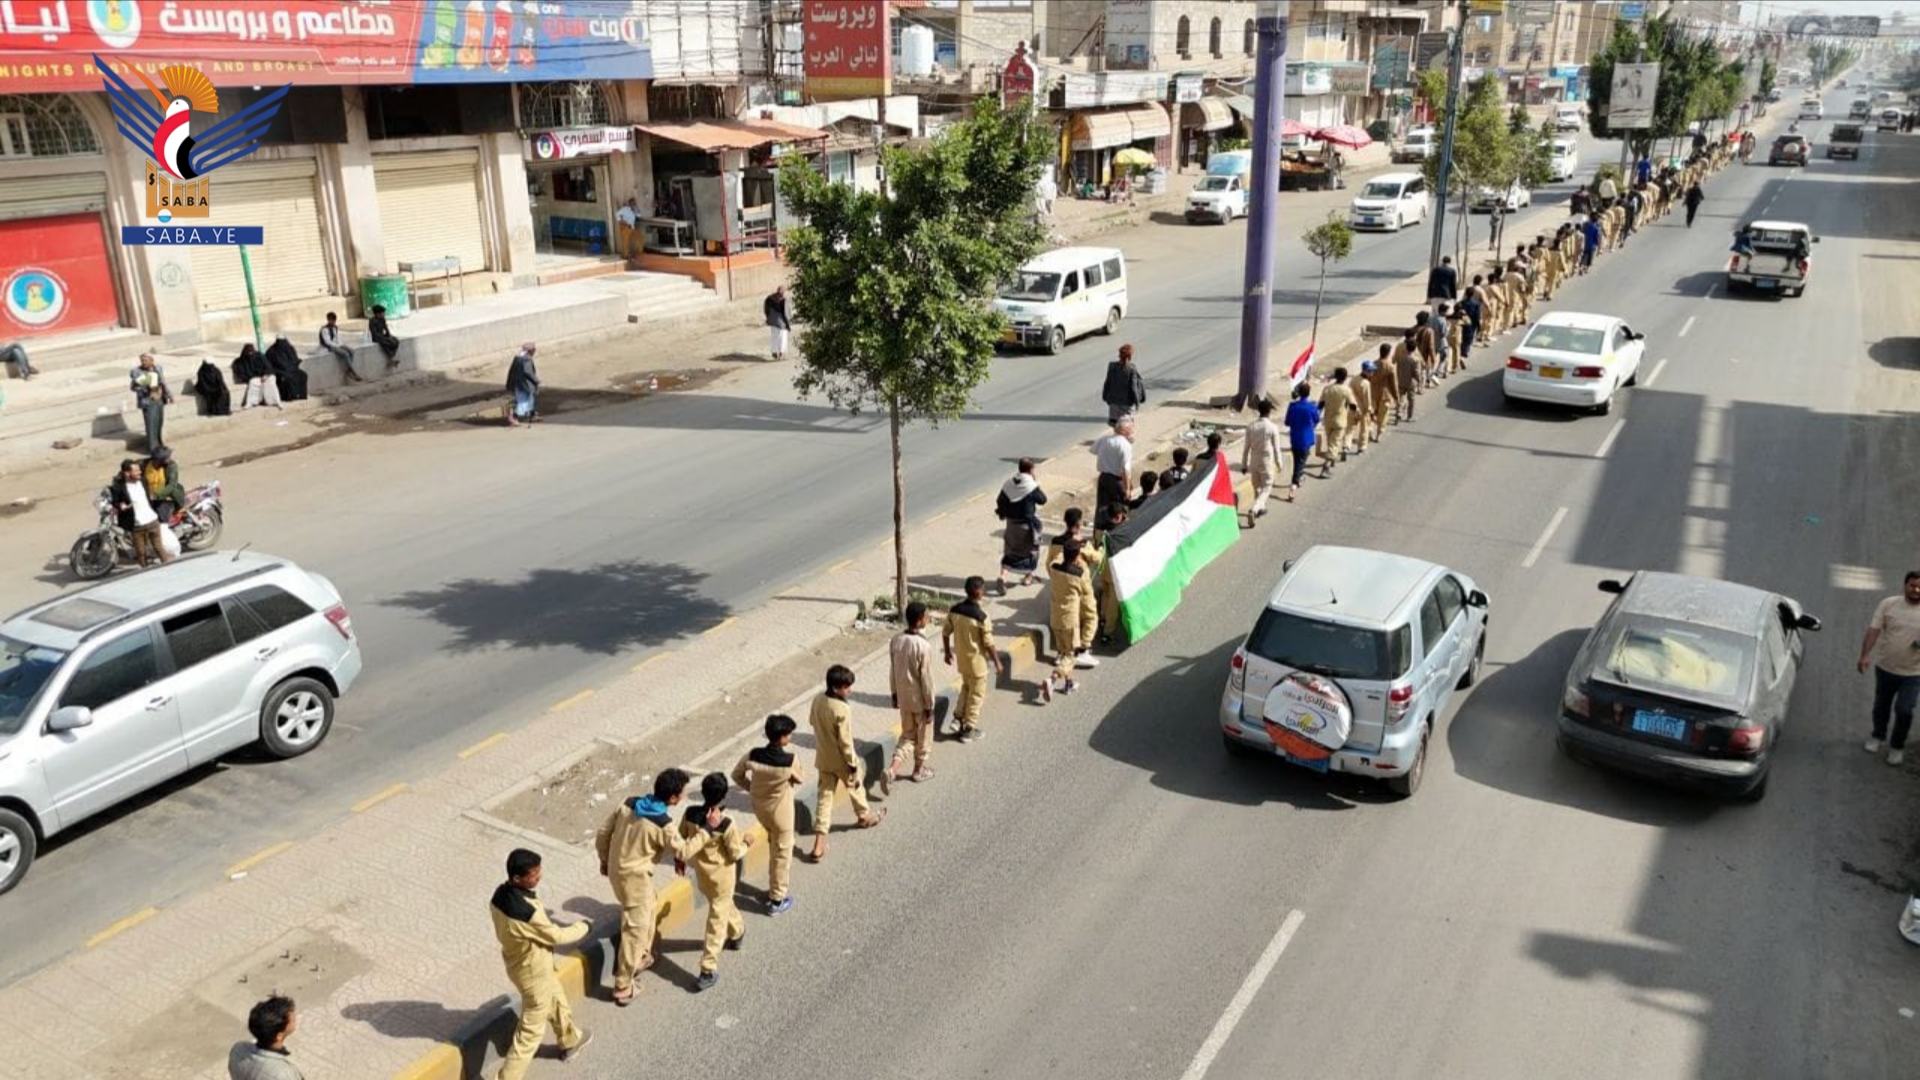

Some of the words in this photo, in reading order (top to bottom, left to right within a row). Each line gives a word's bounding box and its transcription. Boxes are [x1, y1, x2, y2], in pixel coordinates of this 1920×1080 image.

[297, 6, 395, 40] مطاعم
[811, 3, 876, 29] وبروست
[213, 61, 244, 73] AND
[810, 45, 844, 68] العرب
[849, 45, 878, 71] ليالي
